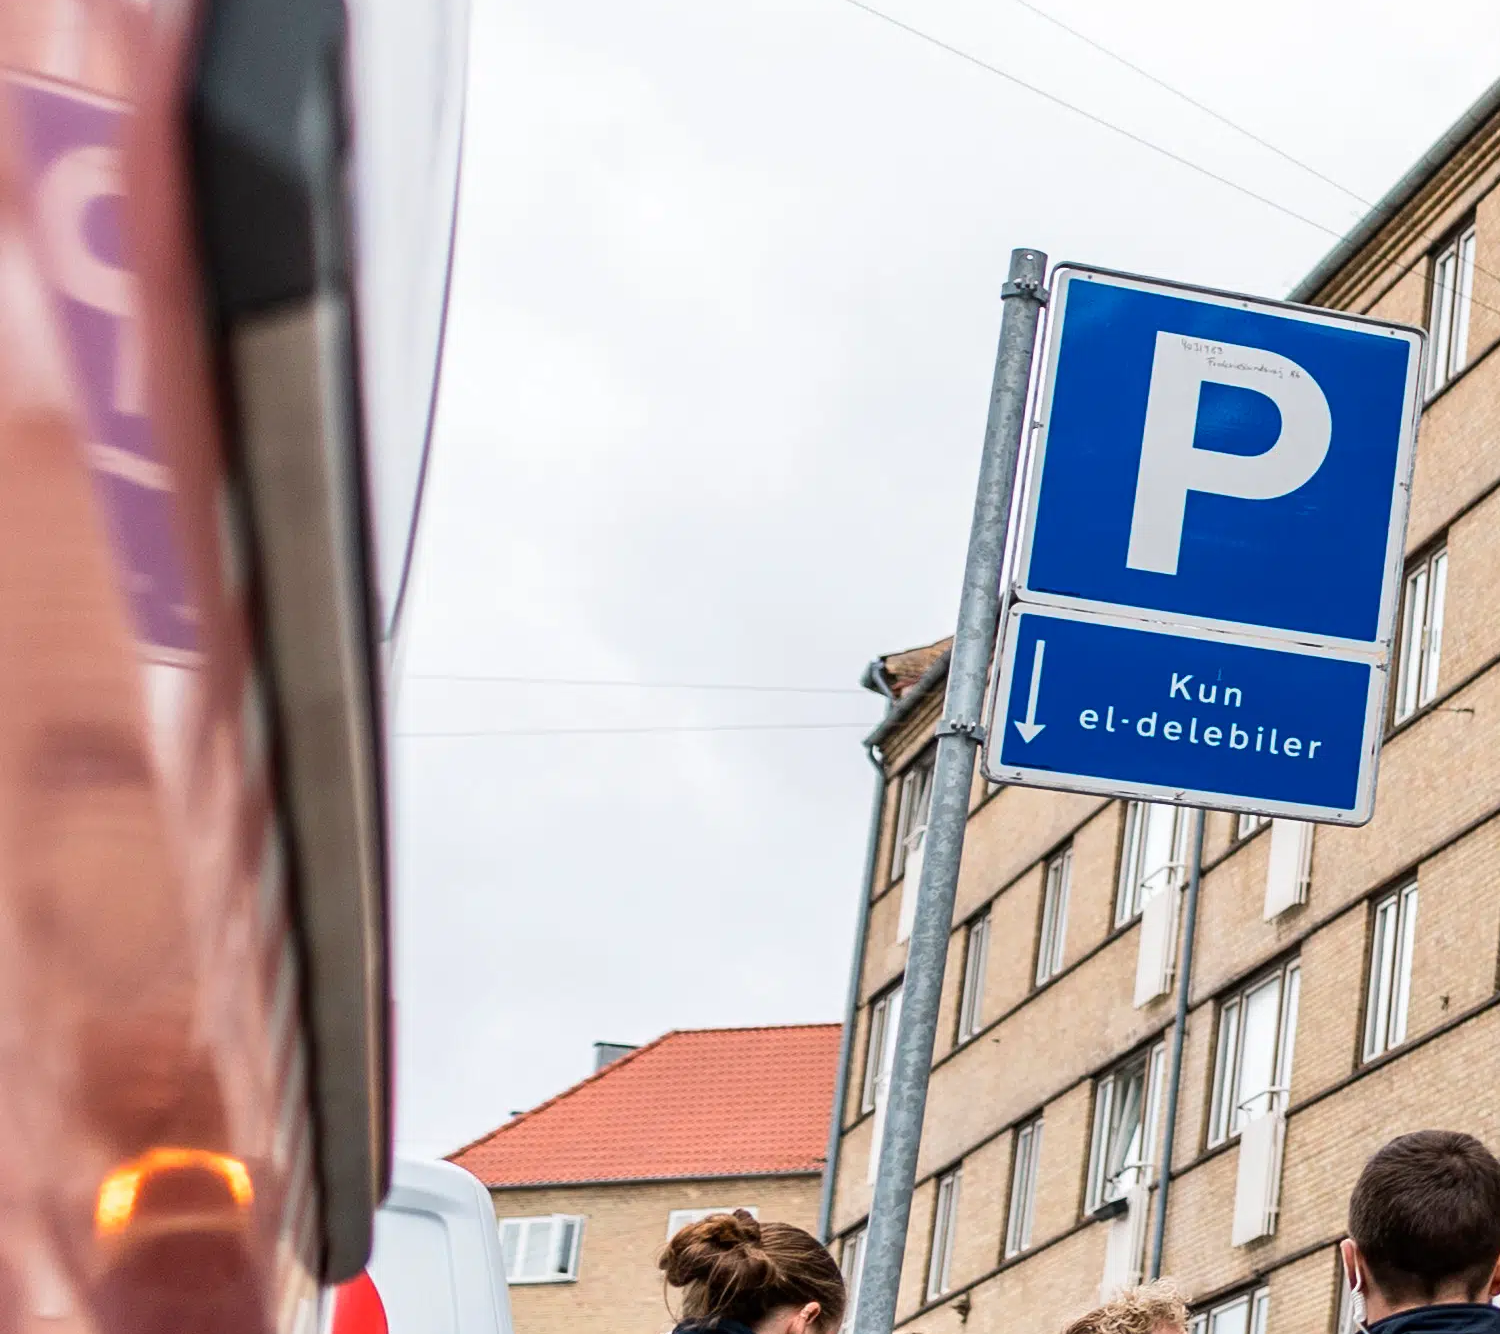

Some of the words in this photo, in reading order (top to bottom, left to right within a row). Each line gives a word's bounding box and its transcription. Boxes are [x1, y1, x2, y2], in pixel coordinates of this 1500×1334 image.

[1126, 330, 1332, 576] P
[1169, 671, 1244, 708] Kun
[1079, 705, 1323, 760] el-delebiler
